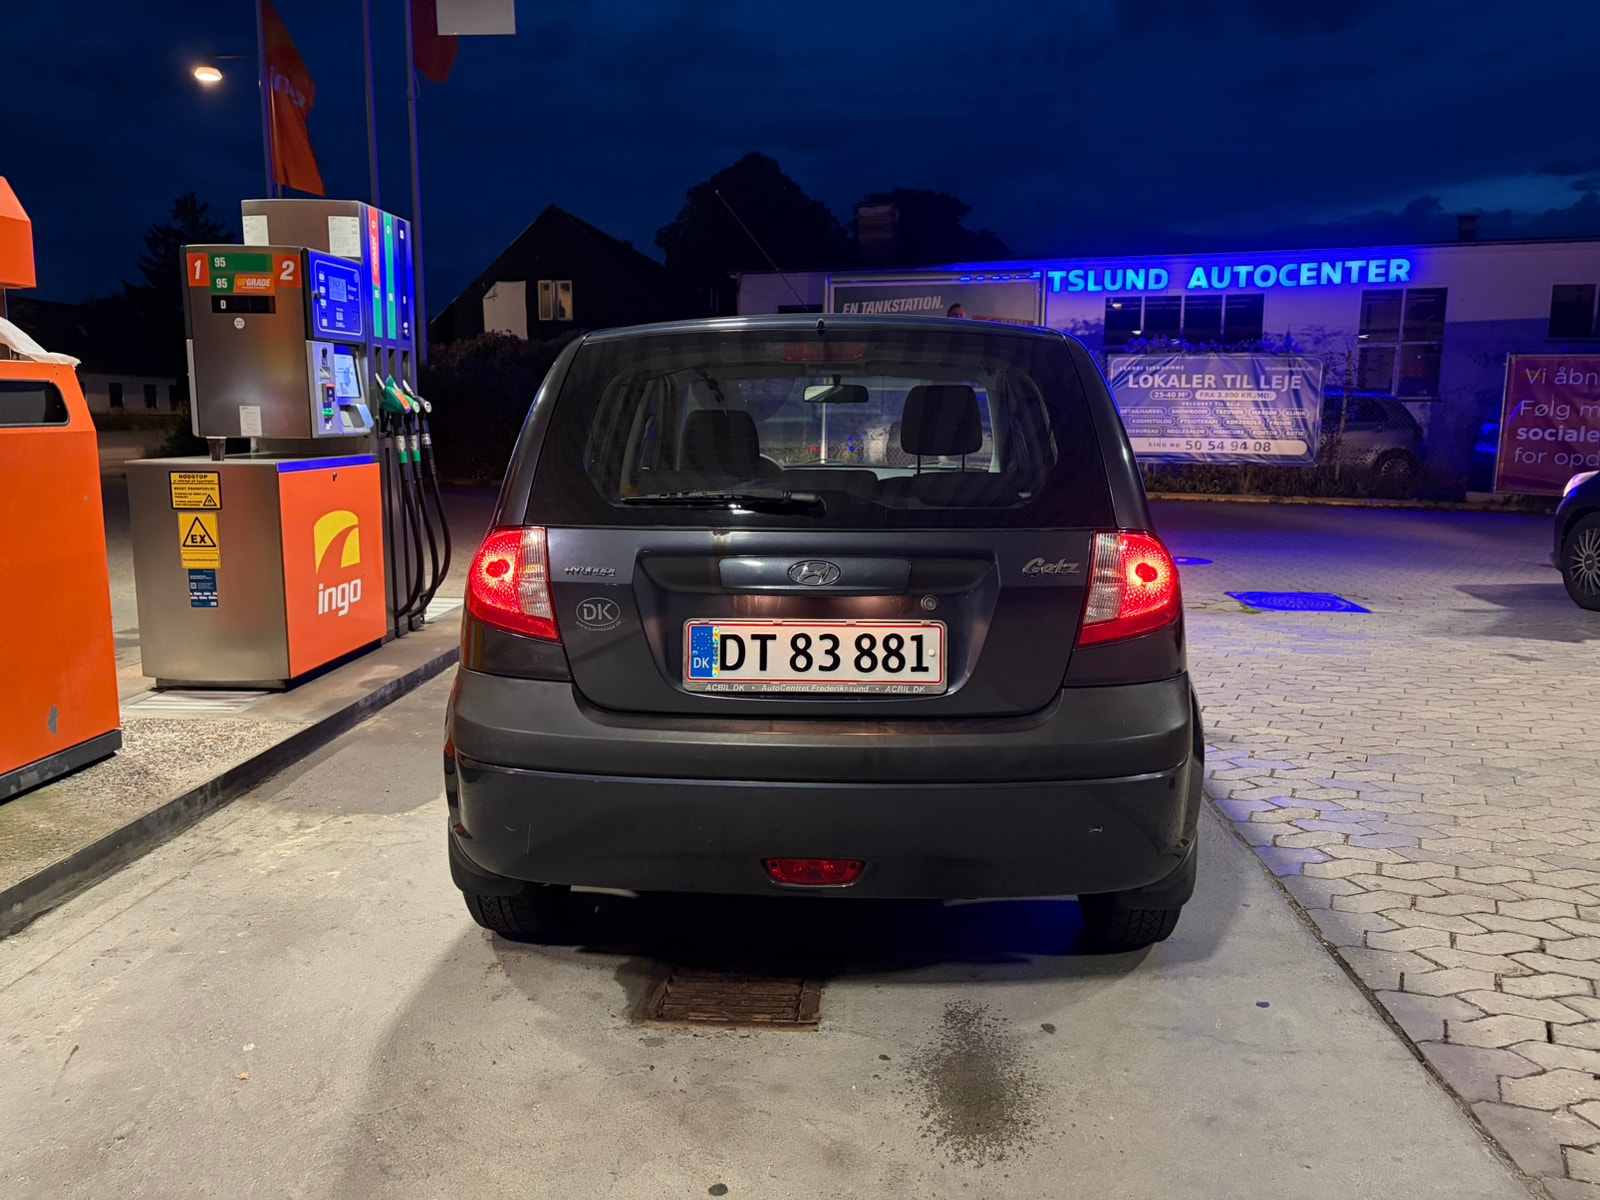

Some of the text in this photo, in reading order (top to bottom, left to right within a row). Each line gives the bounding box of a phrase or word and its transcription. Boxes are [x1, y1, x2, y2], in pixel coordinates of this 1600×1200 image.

[194, 259, 202, 280] 1
[214, 257, 226, 268] 95
[280, 260, 295, 280] 2
[216, 278, 271, 289] 95 UPGRADE
[1047, 258, 1411, 293] TSLUND AUTOCENTER
[842, 296, 944, 314] EN TANKSTATION.
[1128, 374, 1302, 392] LOKALER TIL LEJE
[1524, 368, 1547, 385] Vi
[1519, 399, 1571, 421] Følg
[1516, 425, 1600, 443] sociale
[1185, 440, 1203, 451] 50
[1207, 440, 1225, 451] 54
[1230, 441, 1248, 451] 94
[1253, 441, 1271, 452] 08
[1514, 447, 1547, 464] for
[191, 534, 207, 544] EX
[1022, 557, 1081, 574] Getz
[318, 578, 362, 617] ingo
[583, 603, 614, 621] DK
[693, 657, 710, 669] DK
[719, 633, 777, 671] DT
[789, 633, 841, 673] 83
[853, 633, 930, 673] 881
[705, 684, 745, 692] ACBIL.DK
[811, 684, 870, 693] Frederikssund
[885, 686, 926, 694] ACBIL.DK
